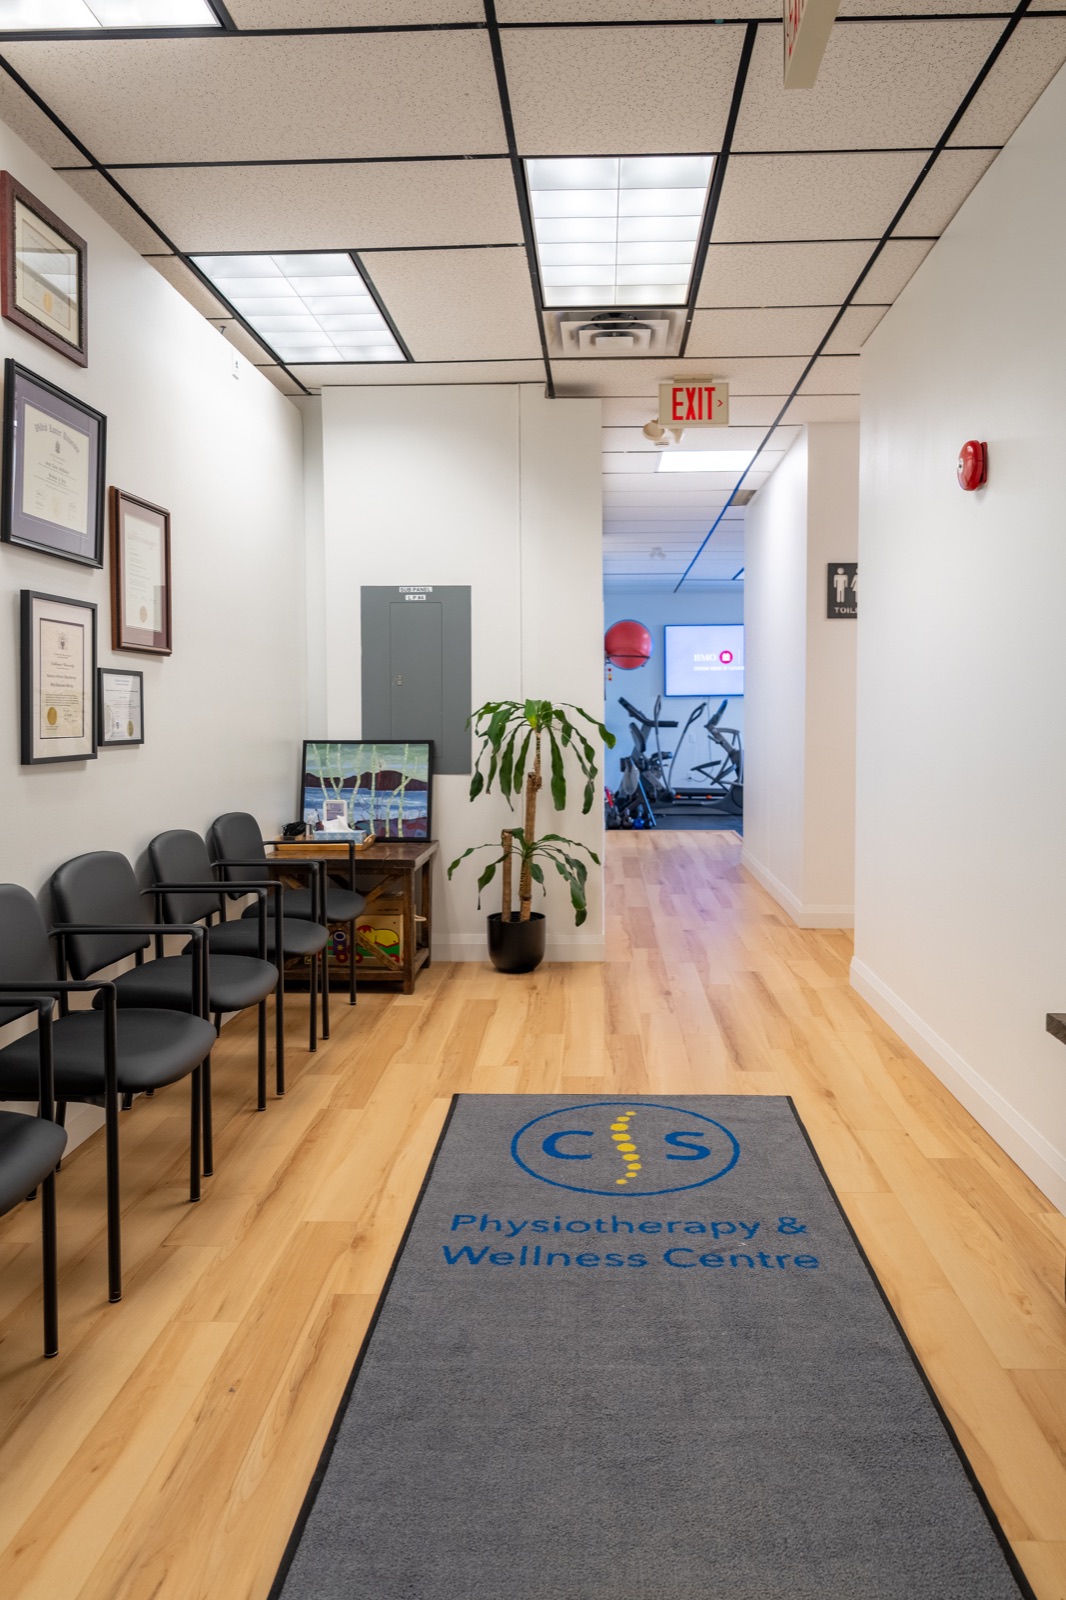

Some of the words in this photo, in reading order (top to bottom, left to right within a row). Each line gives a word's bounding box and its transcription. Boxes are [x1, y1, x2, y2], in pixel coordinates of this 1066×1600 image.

[672, 387, 716, 420] EXIT
[694, 654, 717, 662] BMO
[542, 1130, 594, 1160] C
[664, 1131, 711, 1160] S
[450, 1214, 760, 1240] Physiotherapy
[777, 1216, 807, 1235] &
[442, 1245, 648, 1268] Wellness
[663, 1247, 820, 1270] Centre
